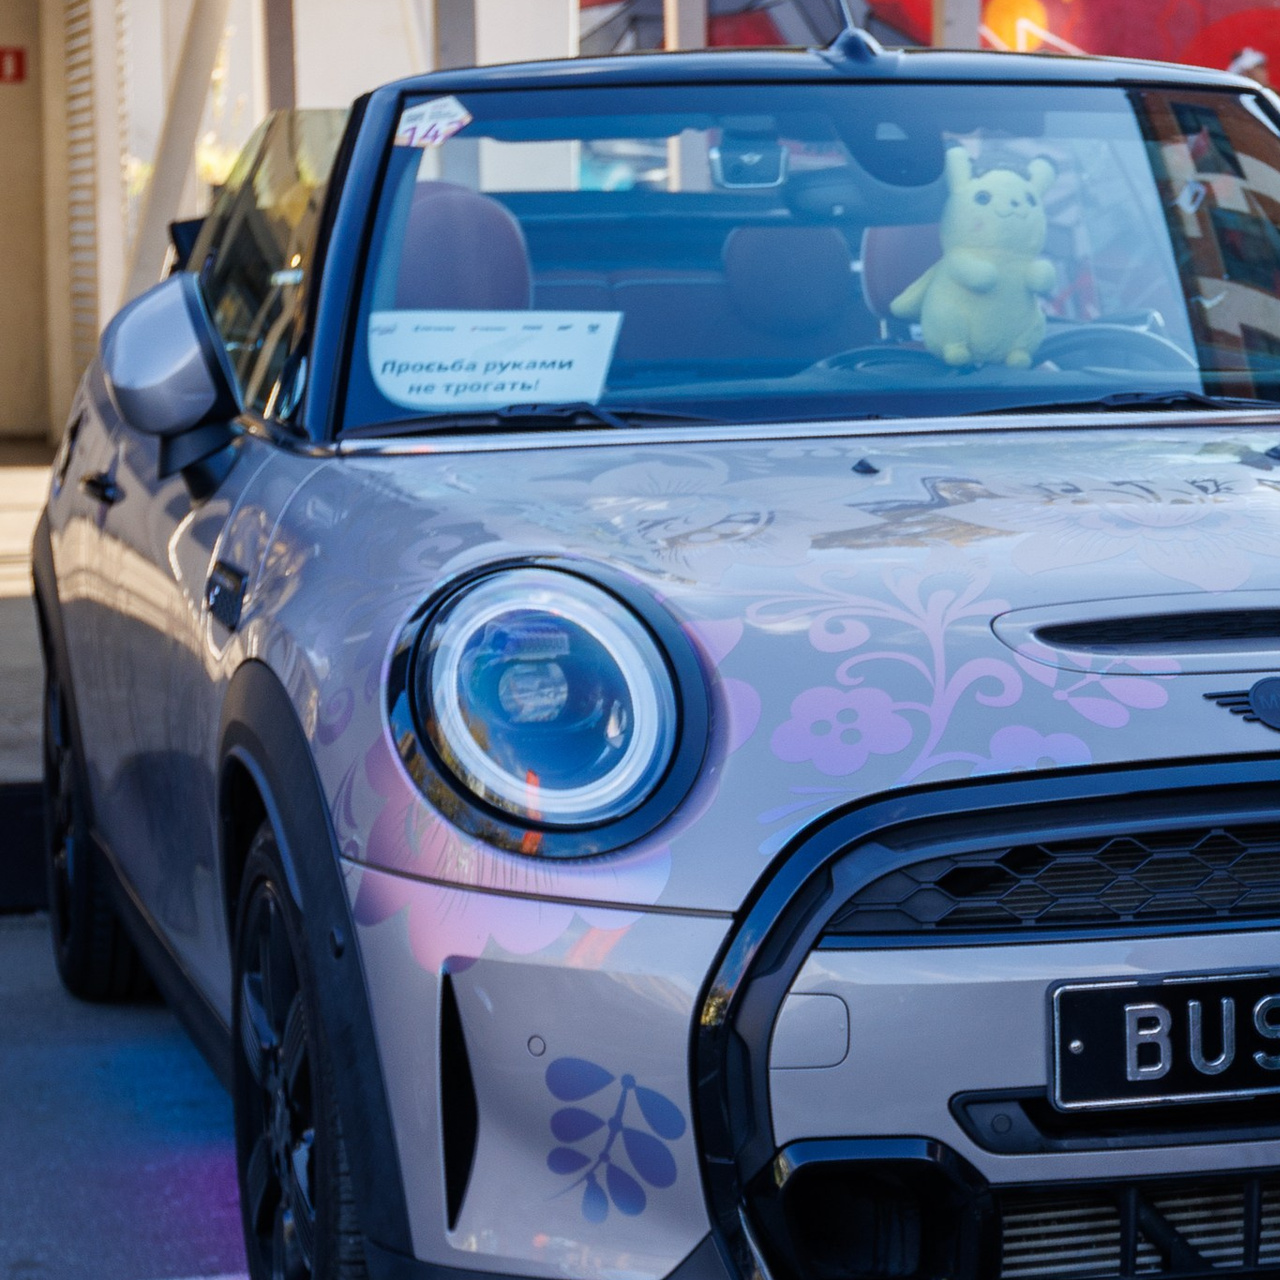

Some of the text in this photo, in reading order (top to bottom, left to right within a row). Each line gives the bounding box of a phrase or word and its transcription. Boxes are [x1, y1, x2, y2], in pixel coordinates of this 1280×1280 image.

[380, 358, 574, 376] Просьба руками
[407, 379, 541, 397] не трогать!
